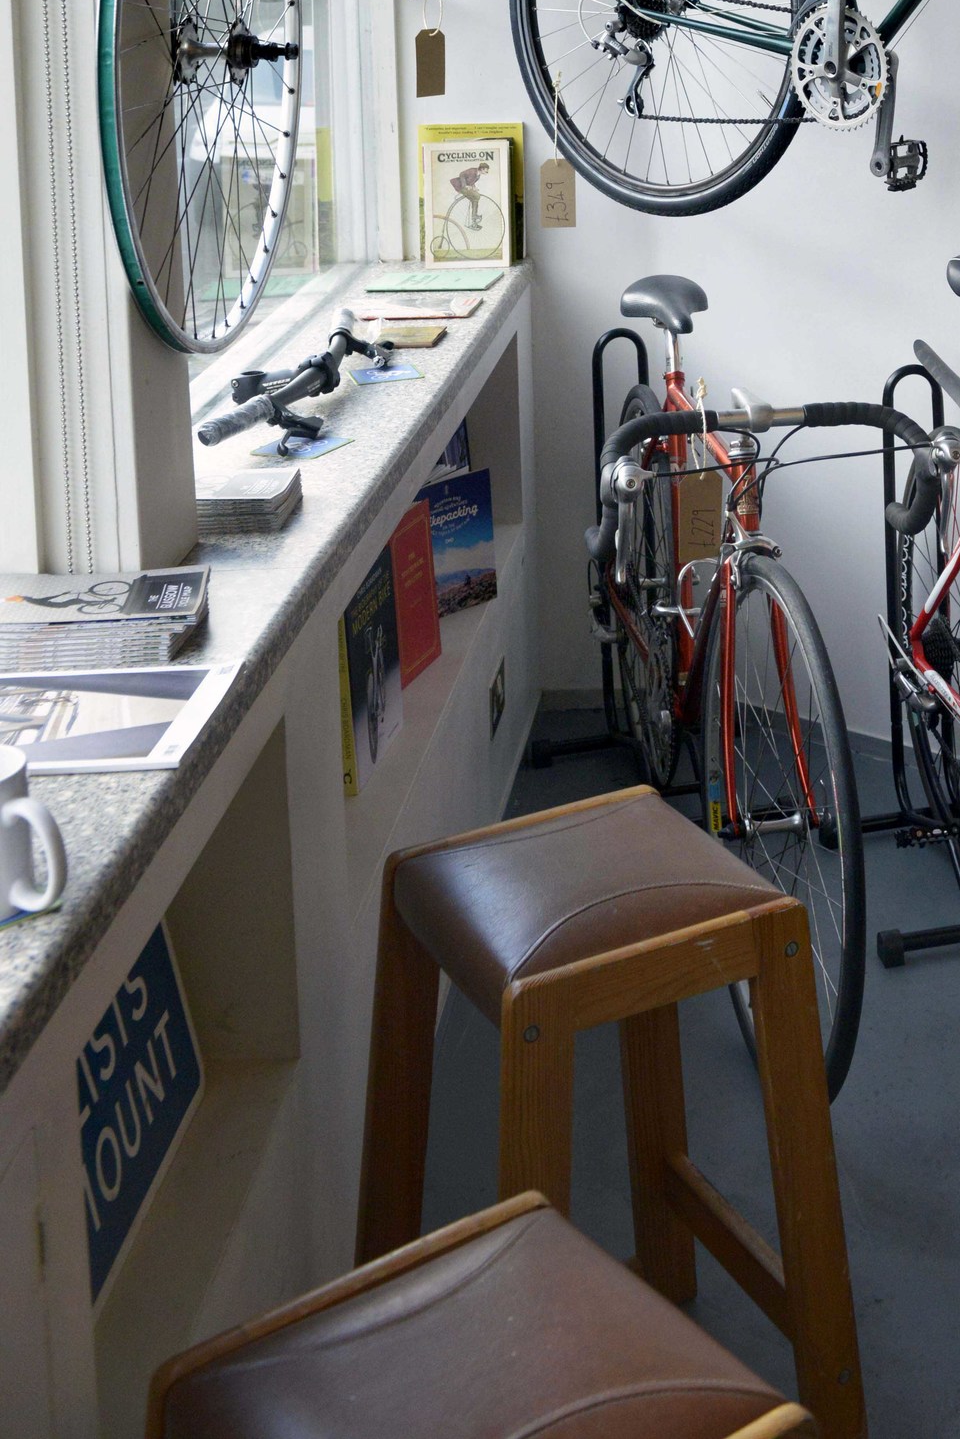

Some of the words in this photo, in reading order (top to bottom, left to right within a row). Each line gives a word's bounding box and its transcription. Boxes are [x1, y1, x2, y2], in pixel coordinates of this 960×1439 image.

[437, 152, 477, 163] CYCLING
[479, 151, 495, 161] ON
[545, 181, 569, 222] £349
[430, 504, 479, 529] ikepacking
[688, 508, 716, 548] £229
[160, 584, 179, 609] GLASGOW
[78, 973, 149, 1118] ISTS
[85, 1009, 178, 1230] OUNT
